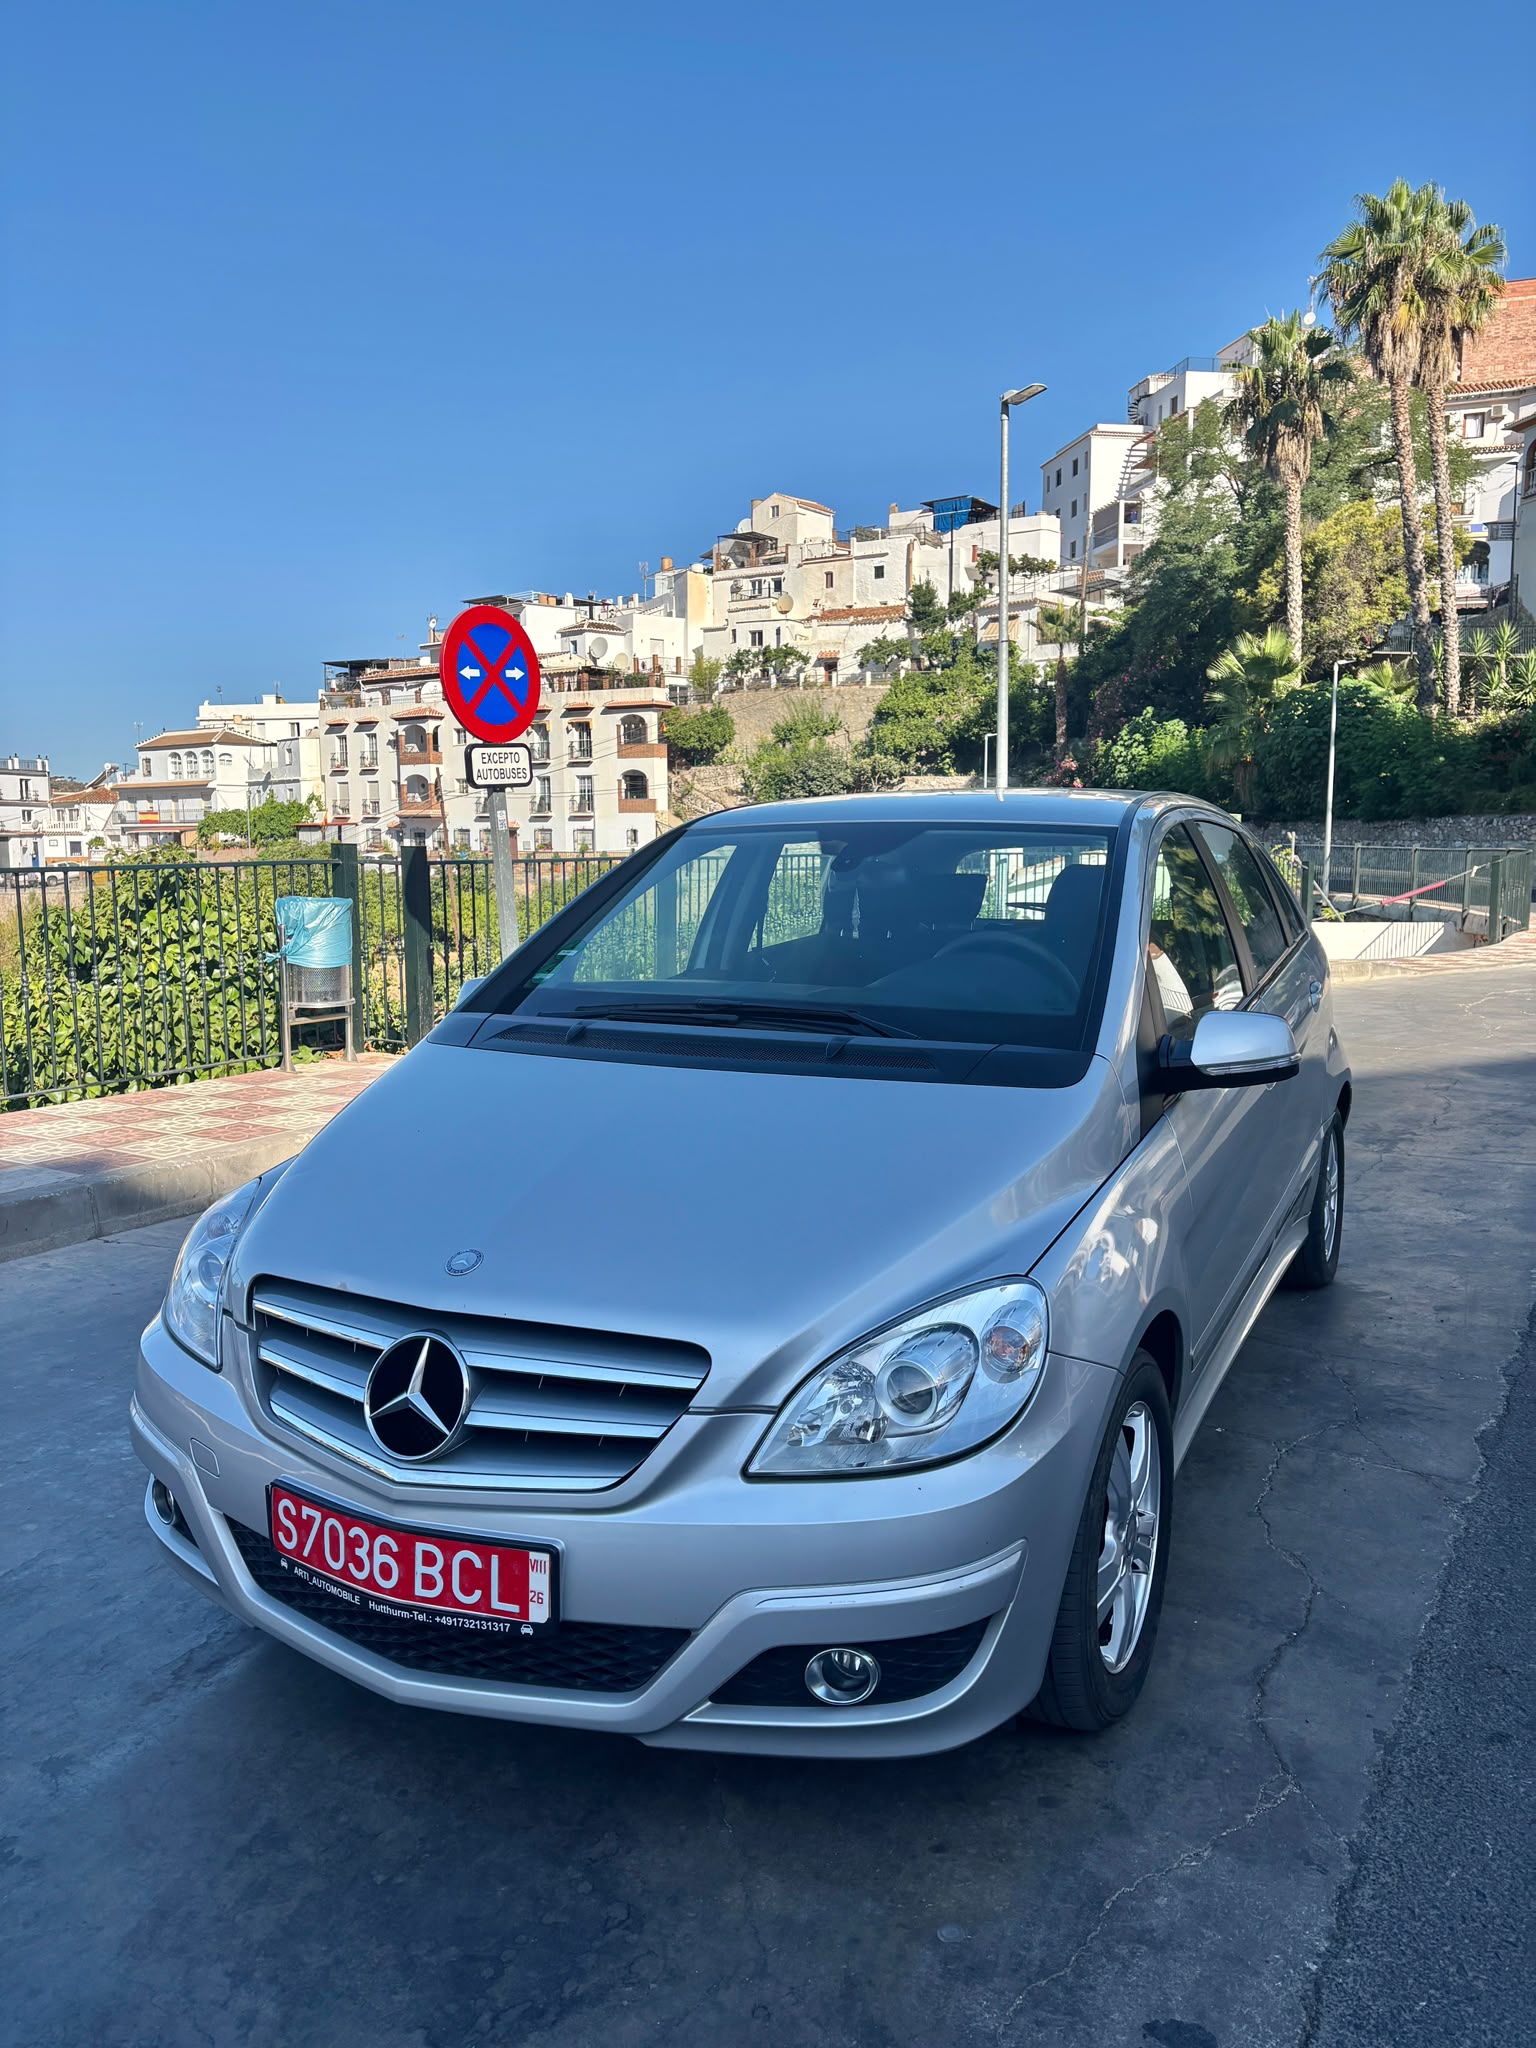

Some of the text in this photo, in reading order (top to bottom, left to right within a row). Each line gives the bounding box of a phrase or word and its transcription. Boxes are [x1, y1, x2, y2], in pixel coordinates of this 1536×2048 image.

[481, 752, 520, 764] EXCEPTO
[476, 767, 528, 781] AUTOBUSES
[277, 1498, 521, 1614] S7036 BCL
[529, 1558, 547, 1575] VIII
[529, 1590, 544, 1605] 26
[434, 1616, 511, 1633] +491732131317
